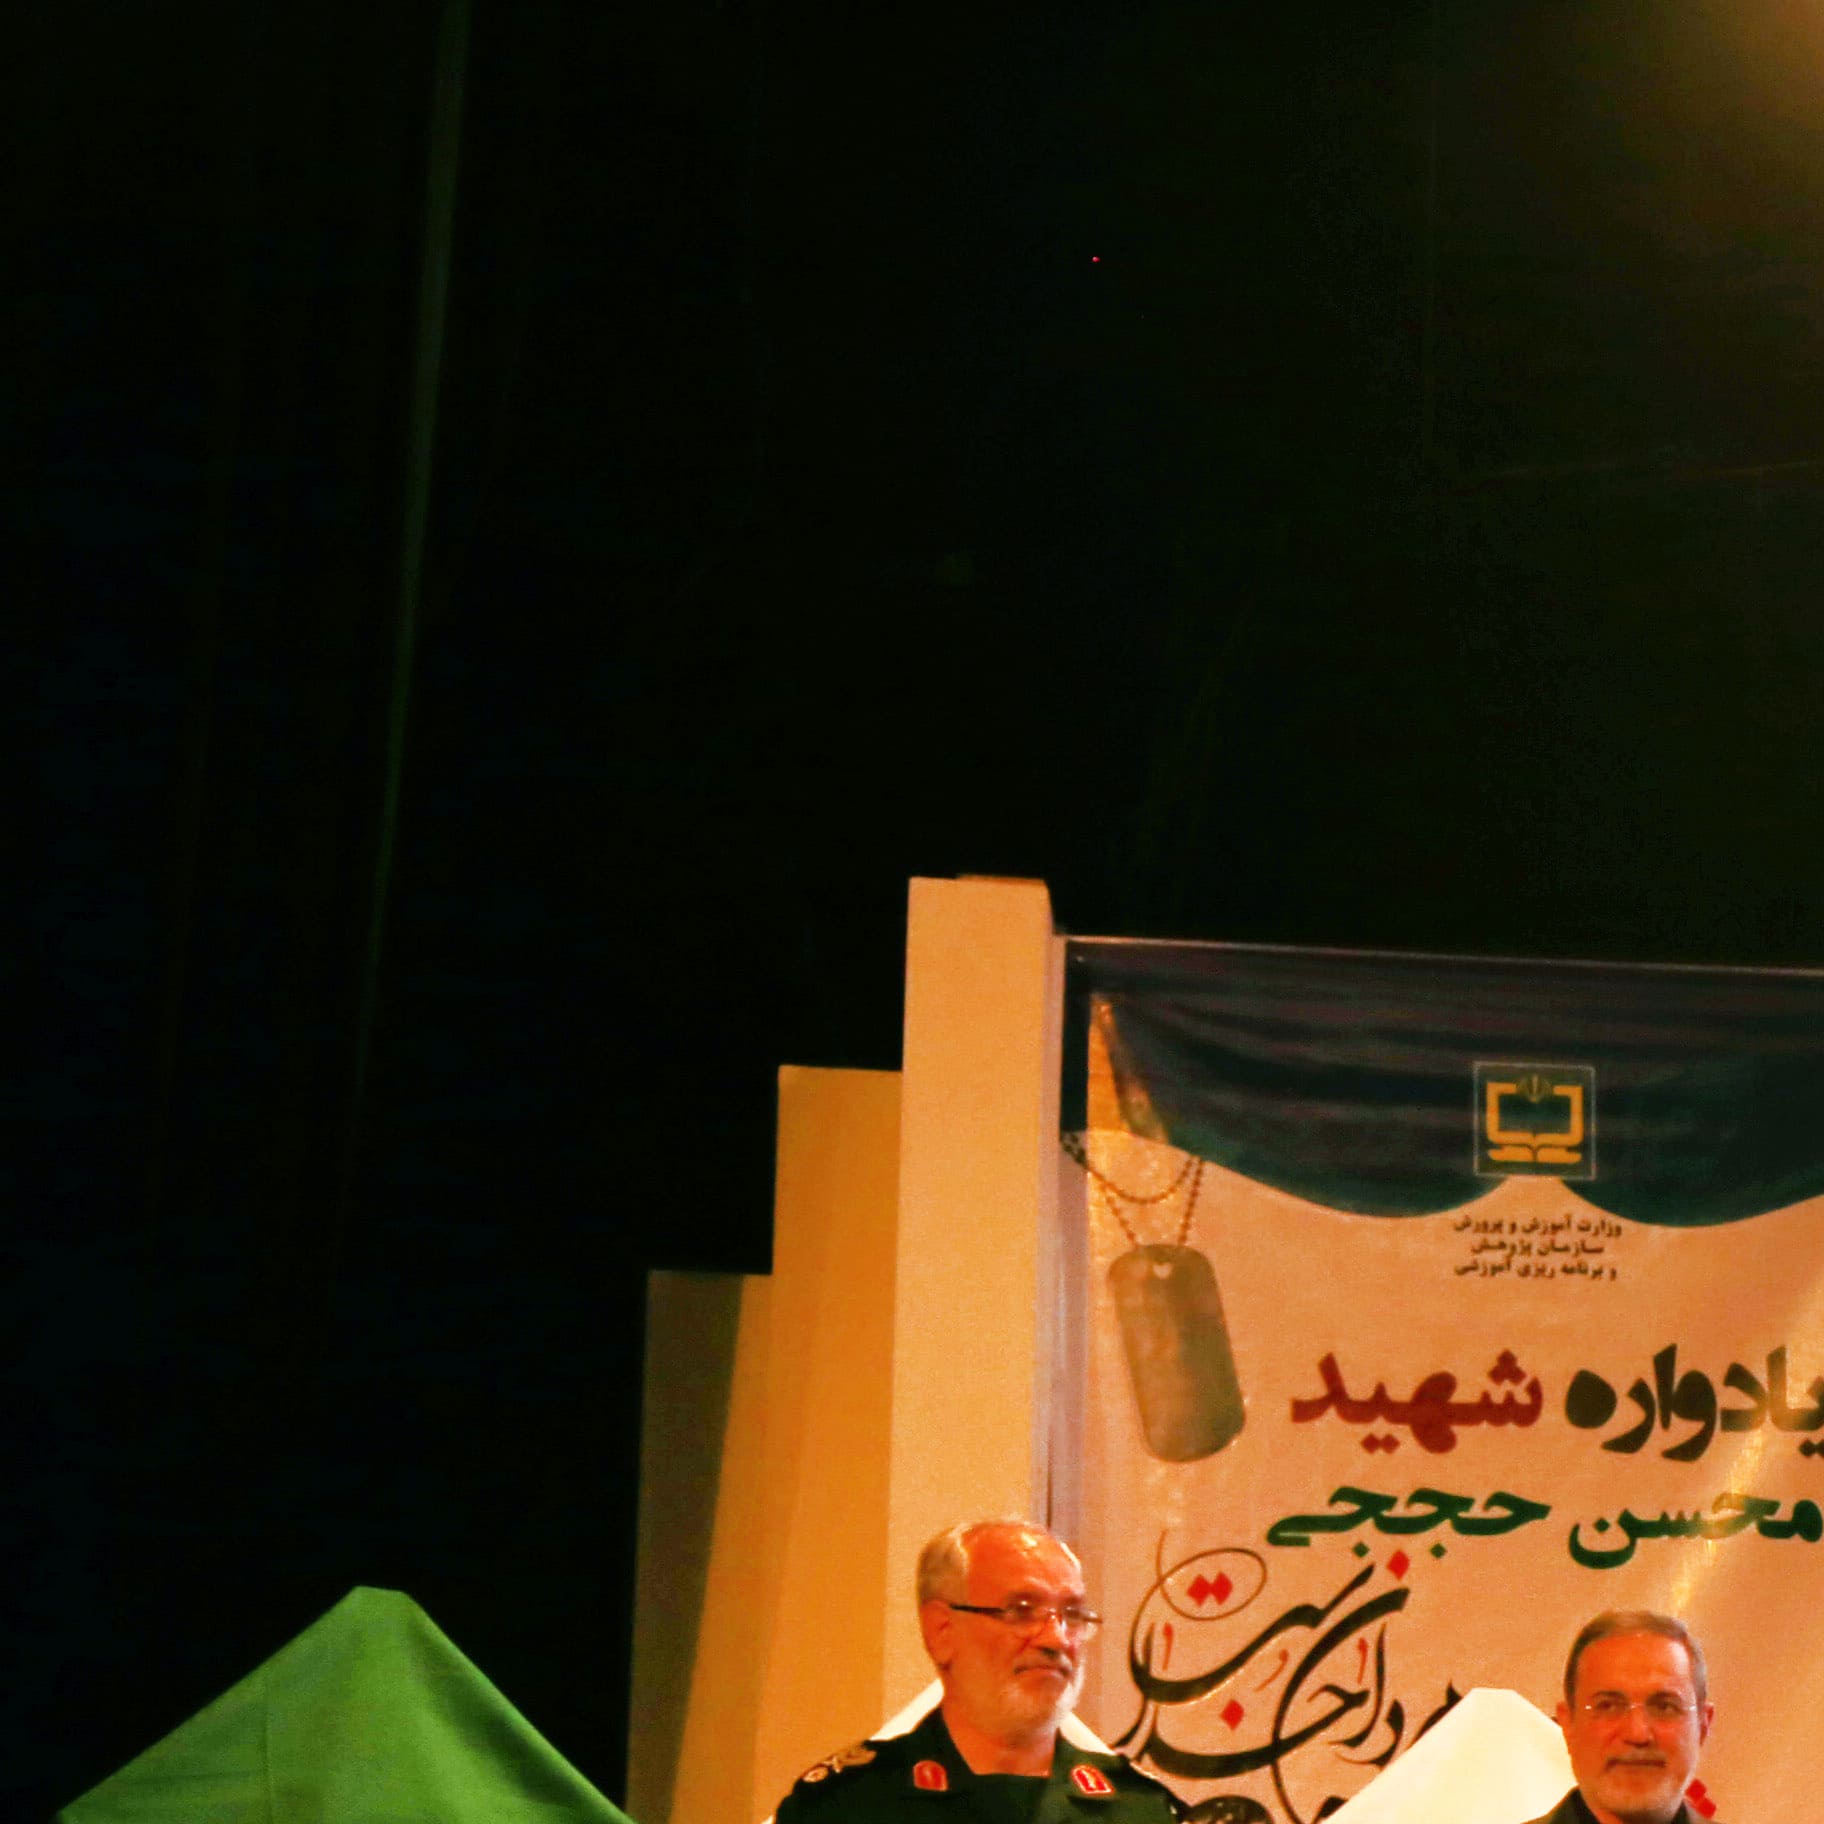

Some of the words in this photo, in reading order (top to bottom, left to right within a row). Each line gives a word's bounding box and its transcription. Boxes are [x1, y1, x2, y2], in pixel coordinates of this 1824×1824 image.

[1453, 1214, 1503, 1235] پرورش
[1521, 1213, 1573, 1236] آموزش
[1577, 1217, 1622, 1238] وزارت
[1471, 1238, 1533, 1258] پژوهش
[1536, 1239, 1604, 1257] سازمان
[1290, 1349, 1544, 1455] شهید
[1266, 1485, 1552, 1560] حججی
[1568, 1492, 1824, 1569] محسن
